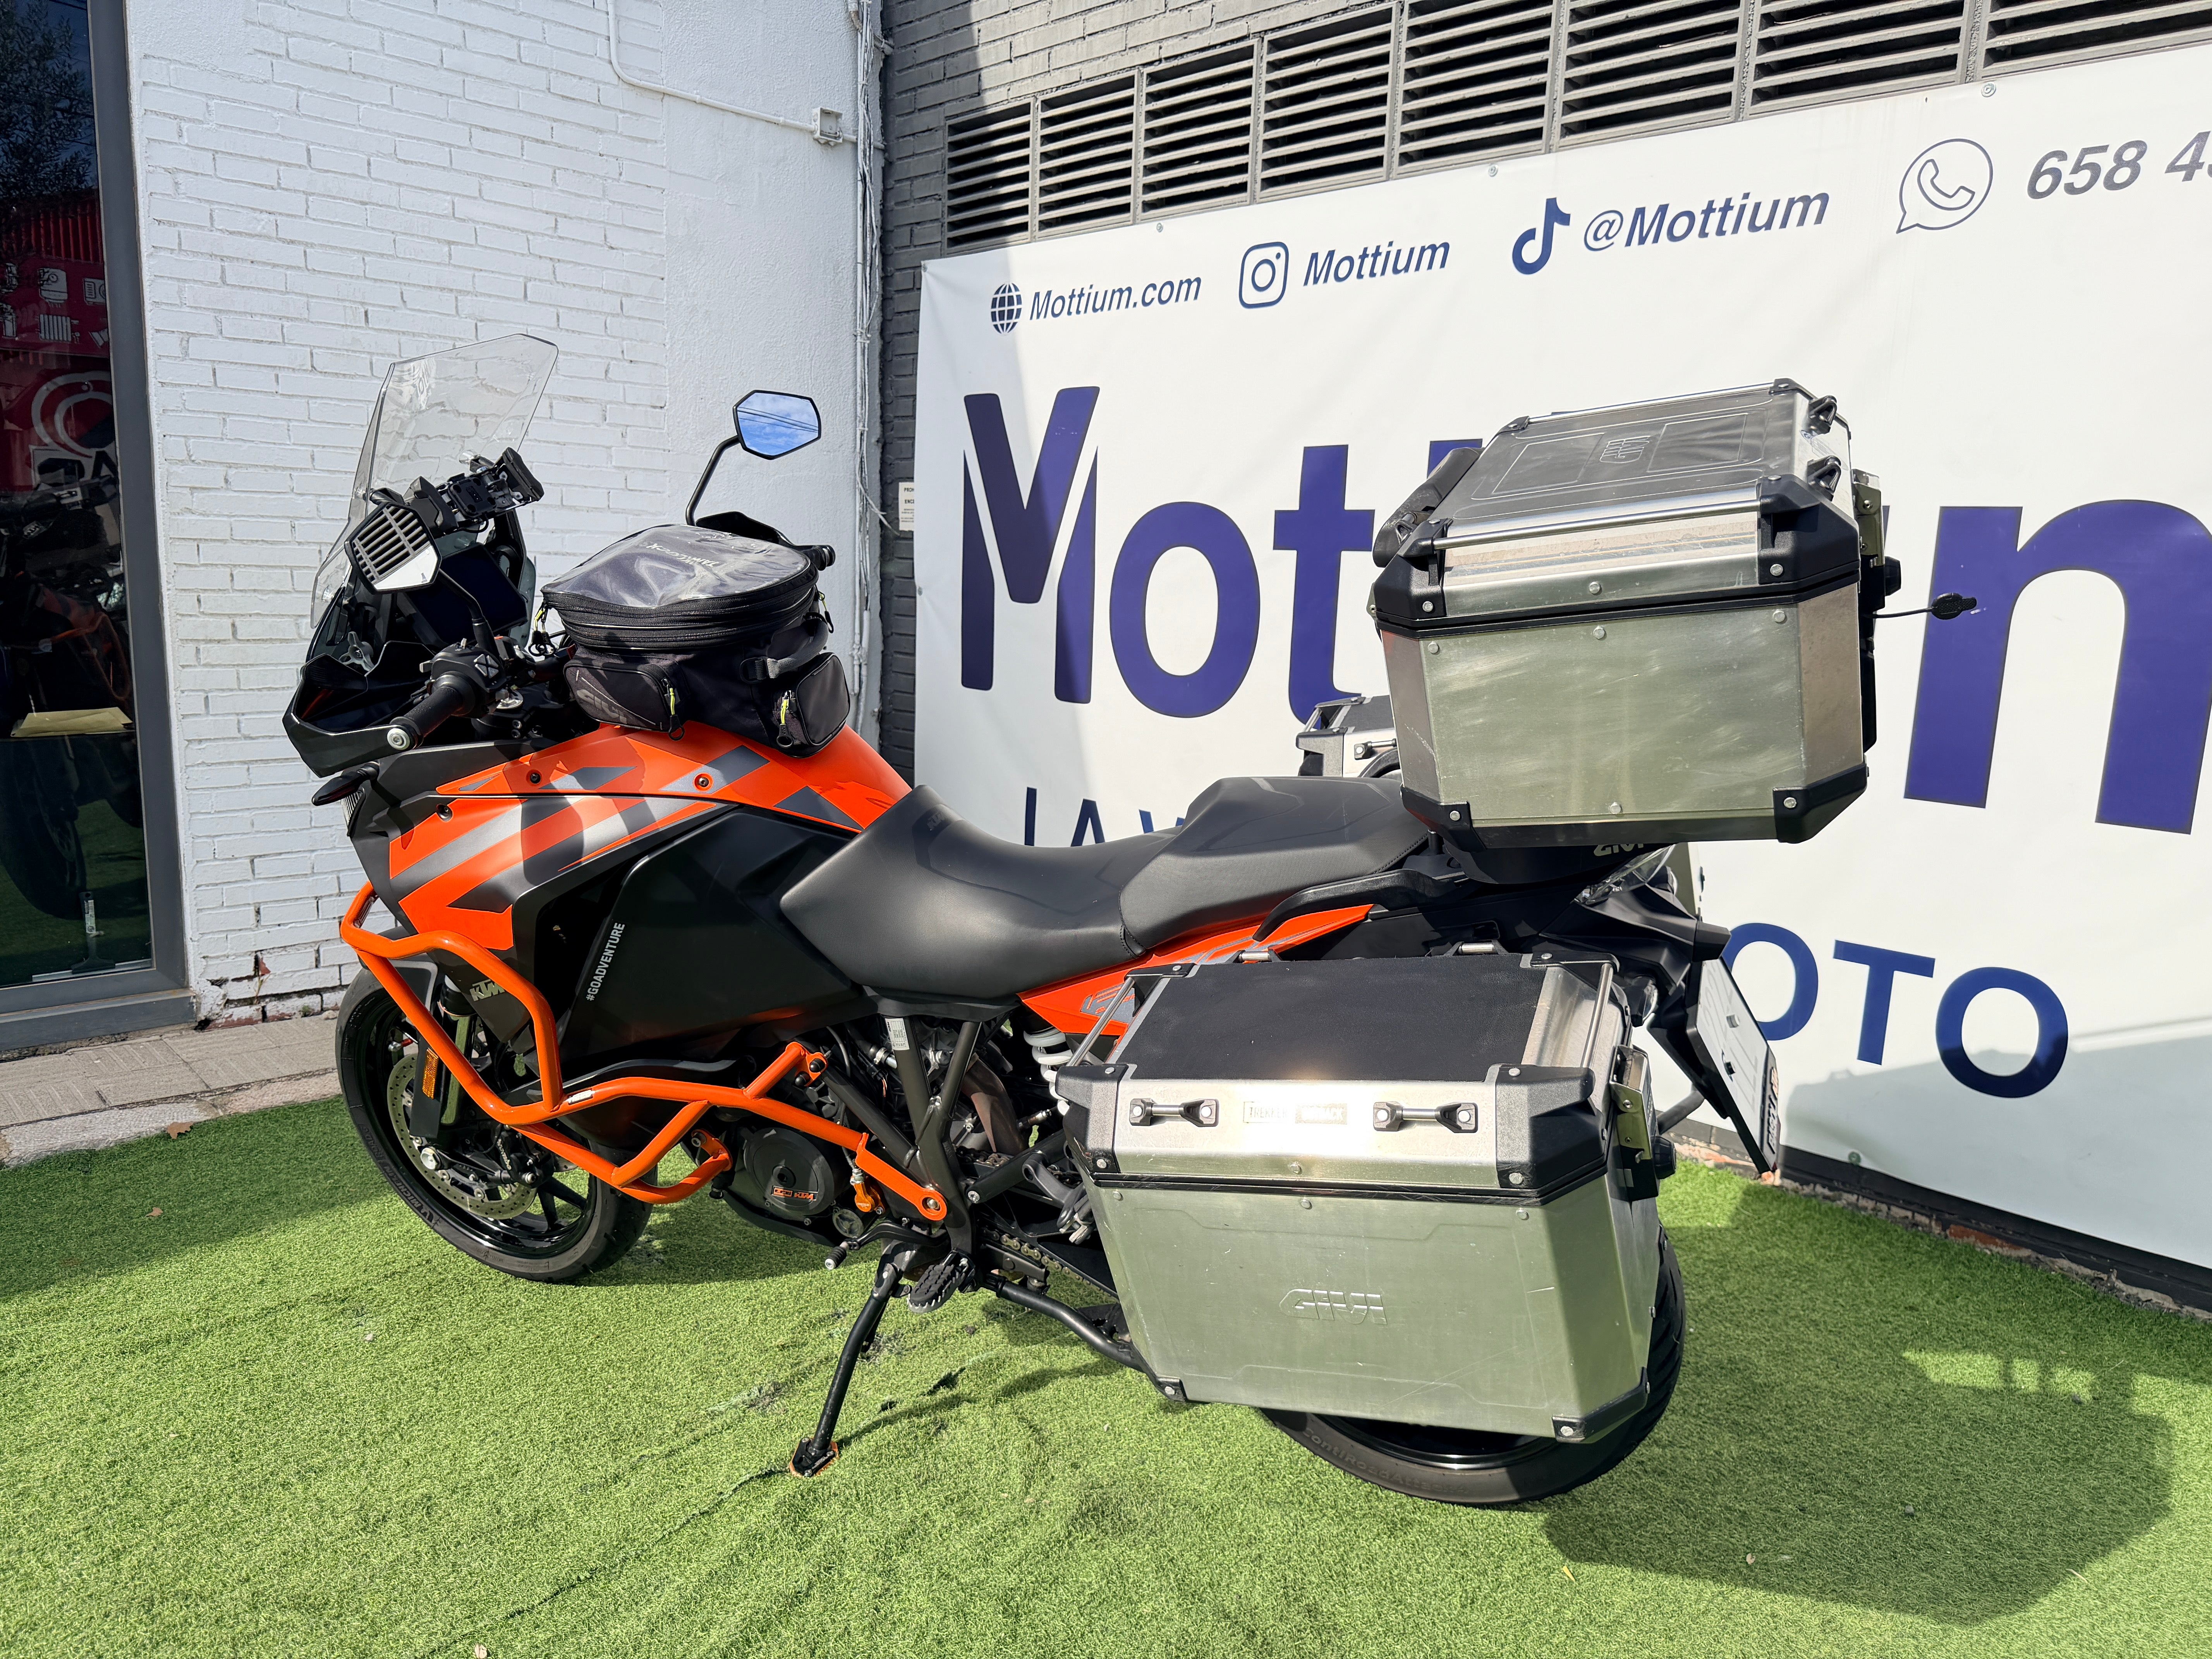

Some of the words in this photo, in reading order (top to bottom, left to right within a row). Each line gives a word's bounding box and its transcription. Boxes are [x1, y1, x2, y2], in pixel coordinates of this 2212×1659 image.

[2027, 140, 2147, 199] 658
[2164, 131, 2212, 182] 4
[1584, 192, 1829, 251] @Mottium
[1304, 241, 1450, 286] Mottium
[1030, 277, 1201, 320] Mottium.com
[586, 922, 625, 1001] #GOADVENTURE
[469, 978, 505, 1002] KTM
[383, 1166, 422, 1208] MICHELIN
[1279, 1288, 1388, 1325] GIVI
